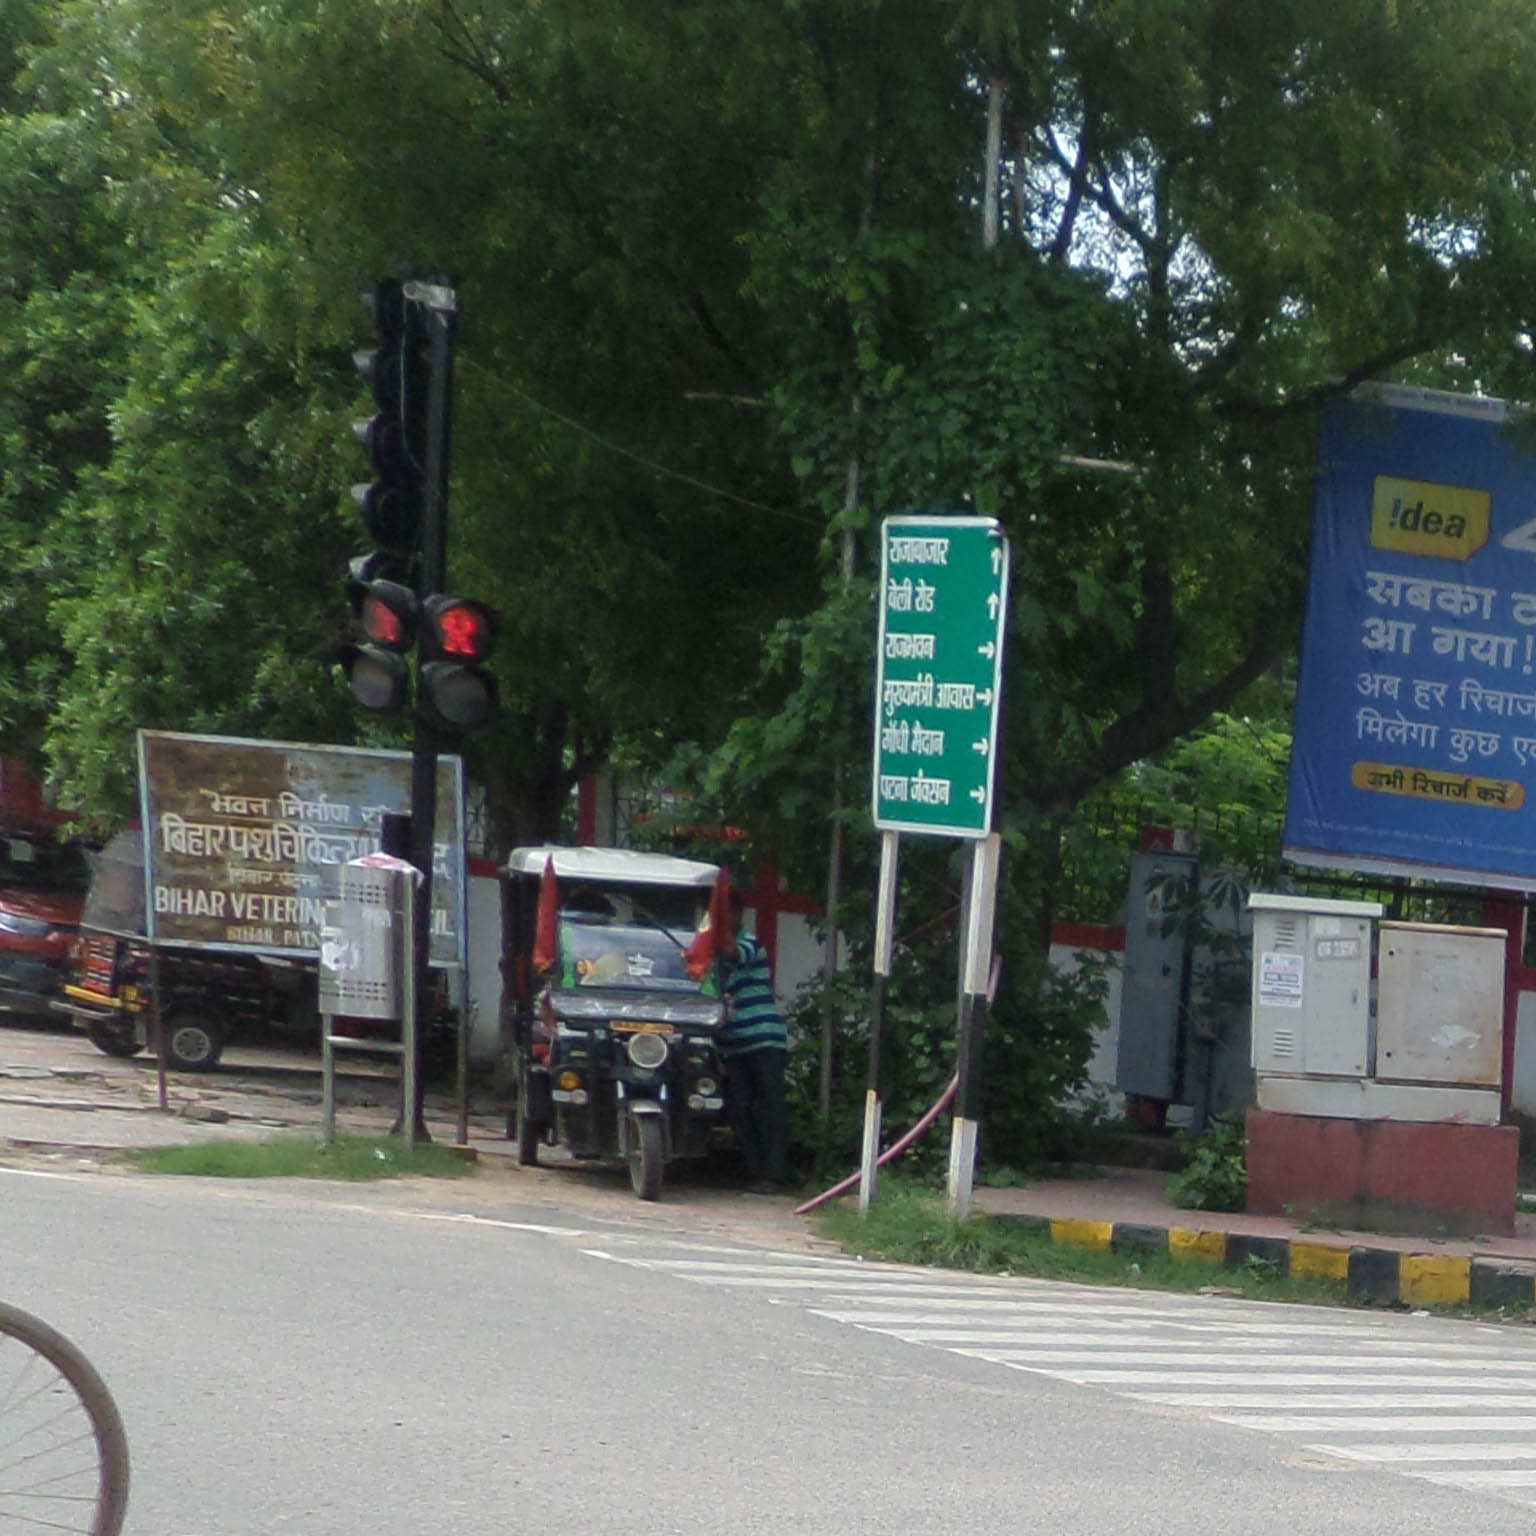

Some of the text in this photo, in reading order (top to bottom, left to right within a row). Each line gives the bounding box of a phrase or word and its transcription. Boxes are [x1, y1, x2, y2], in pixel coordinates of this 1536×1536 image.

[914, 579, 936, 612] रोड
[1365, 570, 1497, 621] सबका
[1361, 616, 1417, 655] आ
[1355, 671, 1402, 701] अब
[1411, 678, 1449, 711] हर
[1354, 706, 1441, 750] मिलेगा
[1448, 727, 1502, 763] कुछ
[879, 774, 909, 803] पटना
[1367, 767, 1405, 788] अभी
[1412, 771, 1472, 799] रिचार्ज
[209, 794, 269, 816] भवन
[278, 791, 351, 824] निर्माण
[154, 886, 227, 918] BIHAR
